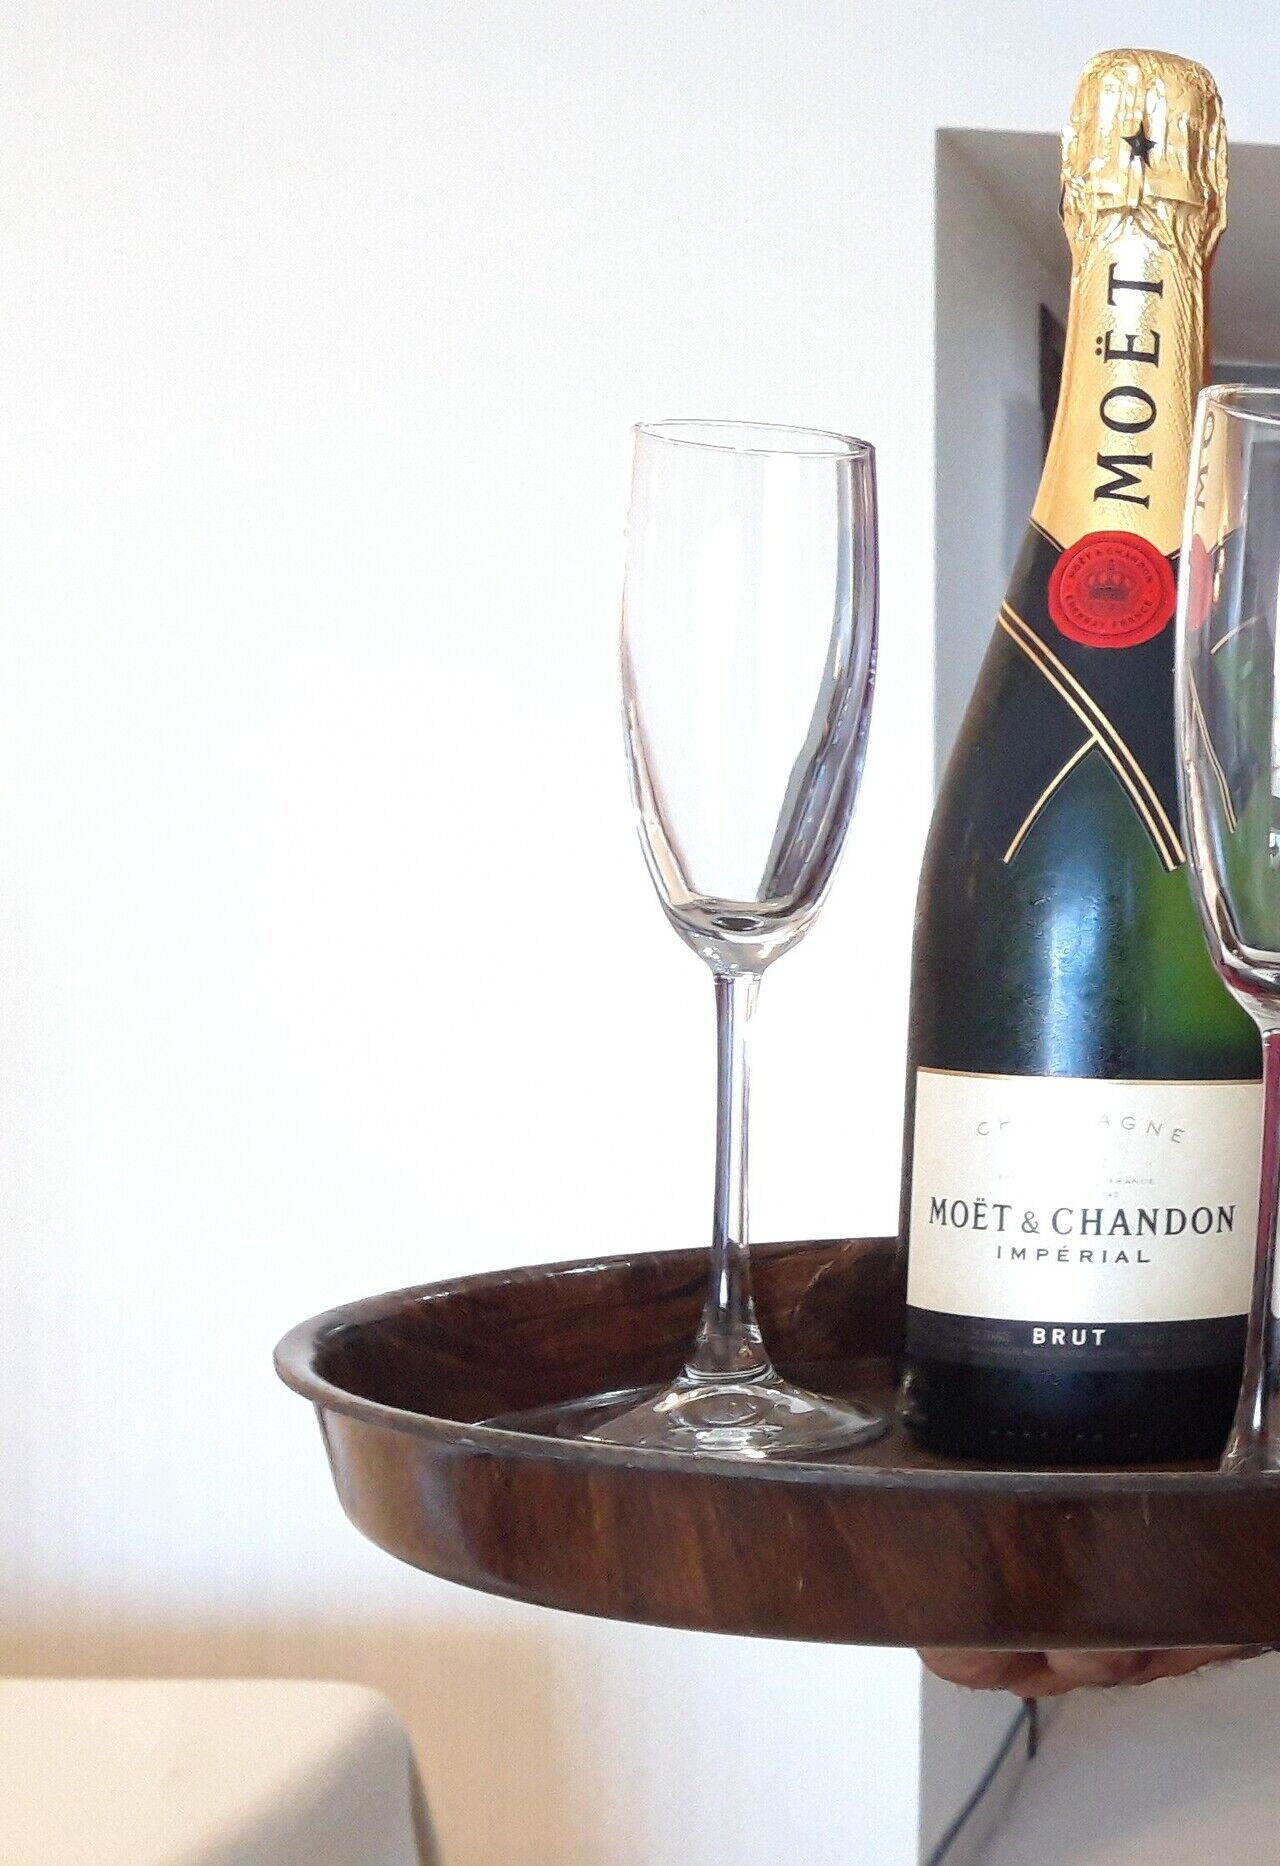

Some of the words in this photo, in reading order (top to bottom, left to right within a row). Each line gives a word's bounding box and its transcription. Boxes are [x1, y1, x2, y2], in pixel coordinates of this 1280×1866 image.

[1093, 263, 1164, 510] MOËT
[976, 1113, 1186, 1144] CAGNE
[928, 1196, 1012, 1233] MOËT
[1021, 1210, 1041, 1235] &
[1051, 1204, 1237, 1237] CHANDON
[997, 1245, 1152, 1264] IMPÉRIAL
[1032, 1327, 1106, 1346] BRUT
